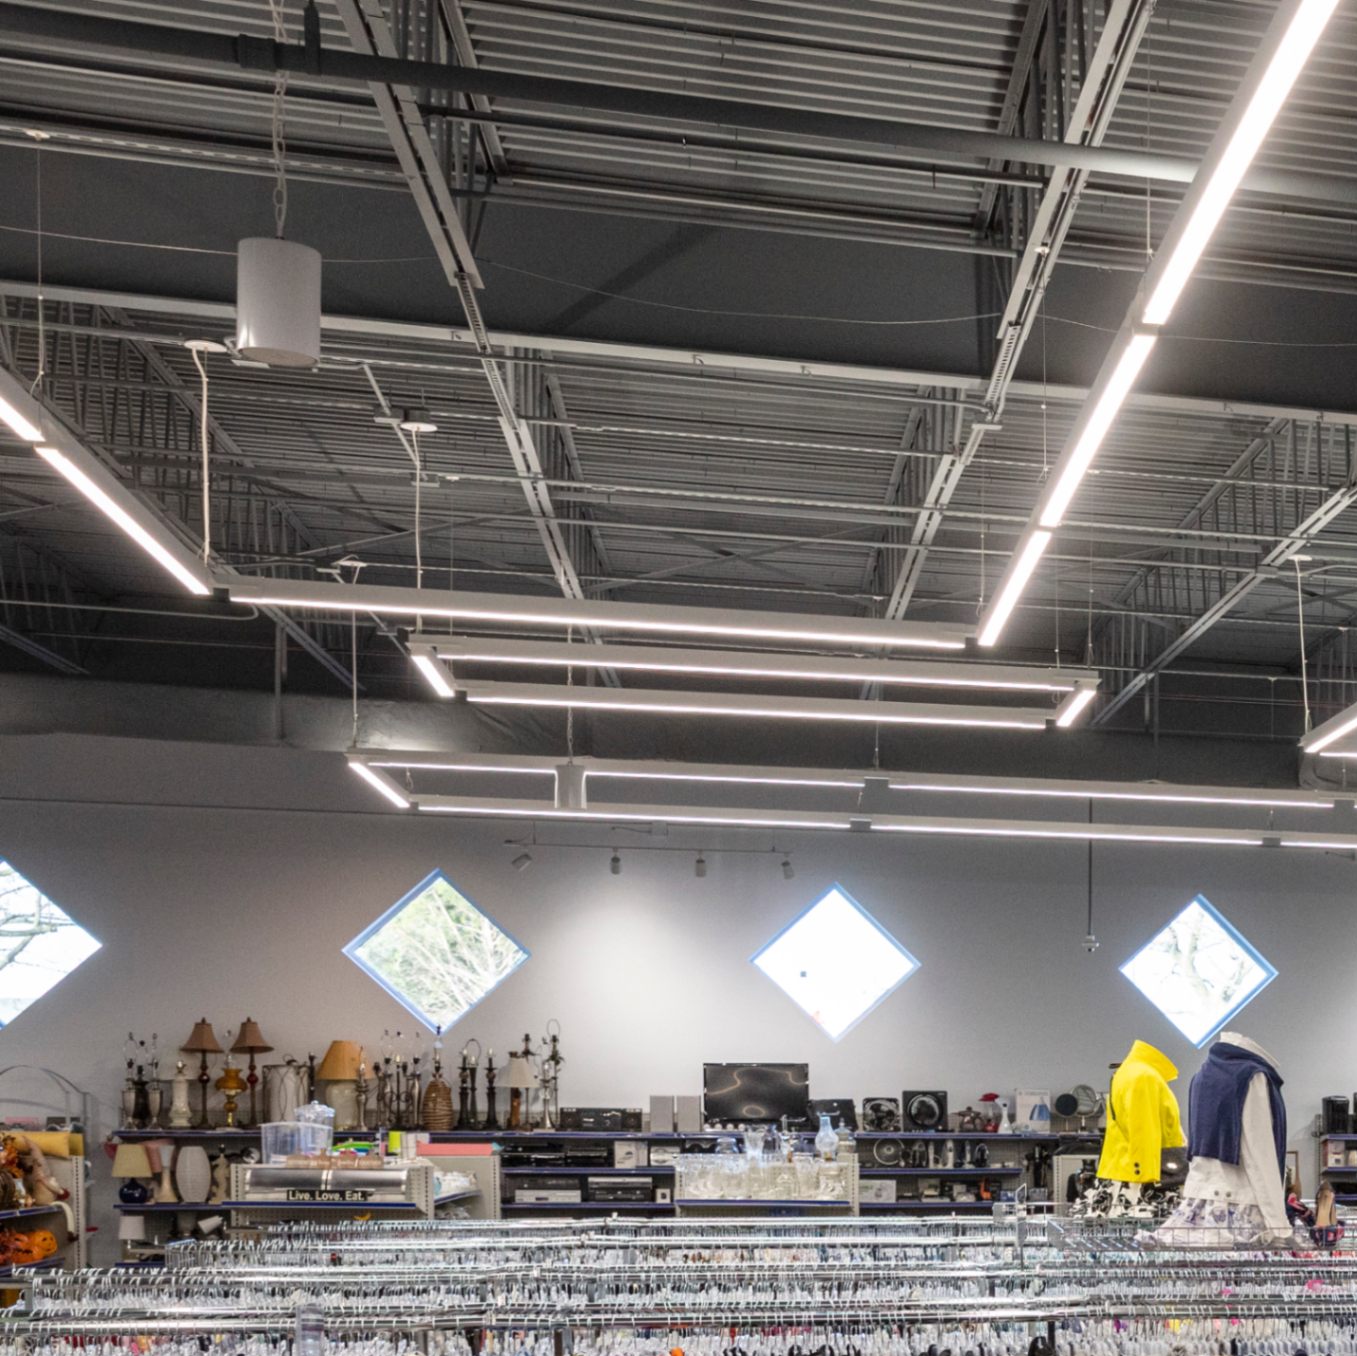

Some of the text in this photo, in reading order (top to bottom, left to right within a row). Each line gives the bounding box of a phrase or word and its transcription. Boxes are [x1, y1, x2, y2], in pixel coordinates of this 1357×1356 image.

[289, 1190, 365, 1200] Live. Love. Eat.
